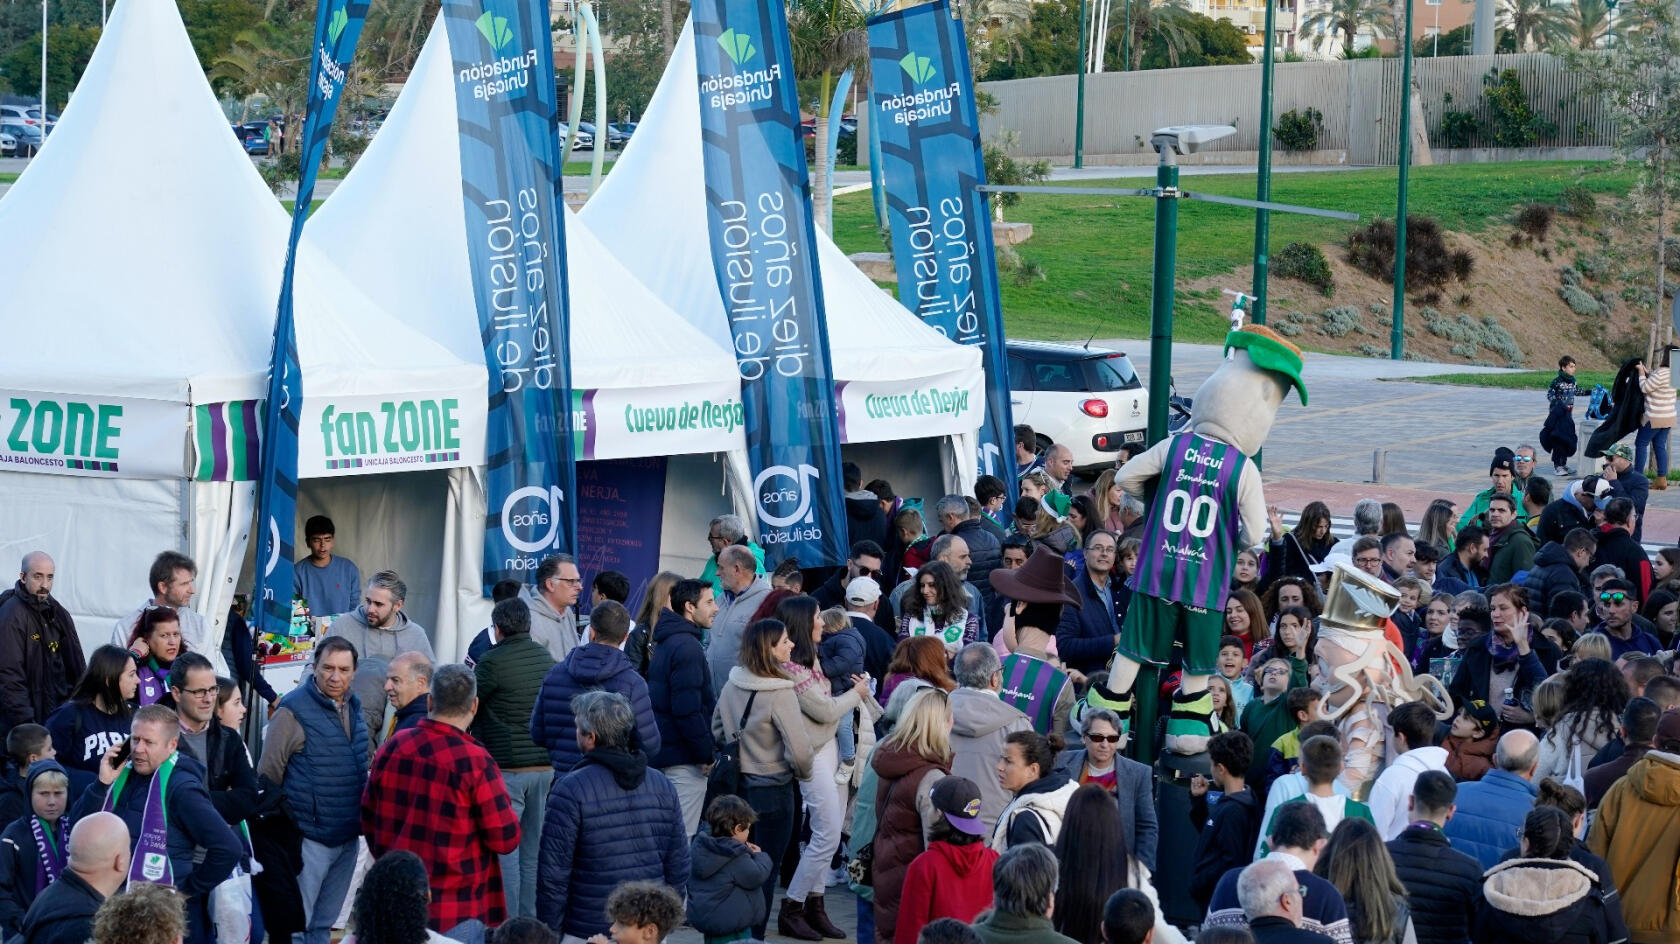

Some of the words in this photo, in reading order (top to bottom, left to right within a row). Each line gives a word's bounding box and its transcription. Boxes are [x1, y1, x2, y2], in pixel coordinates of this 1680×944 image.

[624, 403, 676, 432] Cueva
[678, 401, 699, 430] de
[700, 398, 744, 434] Nerja
[865, 393, 912, 418] Cueva
[910, 389, 932, 416] de
[930, 386, 968, 418] Nerja
[6, 398, 123, 459] ZONE
[380, 398, 460, 452] ZONE
[14, 456, 64, 466] BALONCESTO
[364, 458, 389, 466] UNICAJA
[390, 455, 424, 464] BALONCESTO
[1184, 448, 1225, 470] Chicui
[1163, 489, 1218, 538] 00
